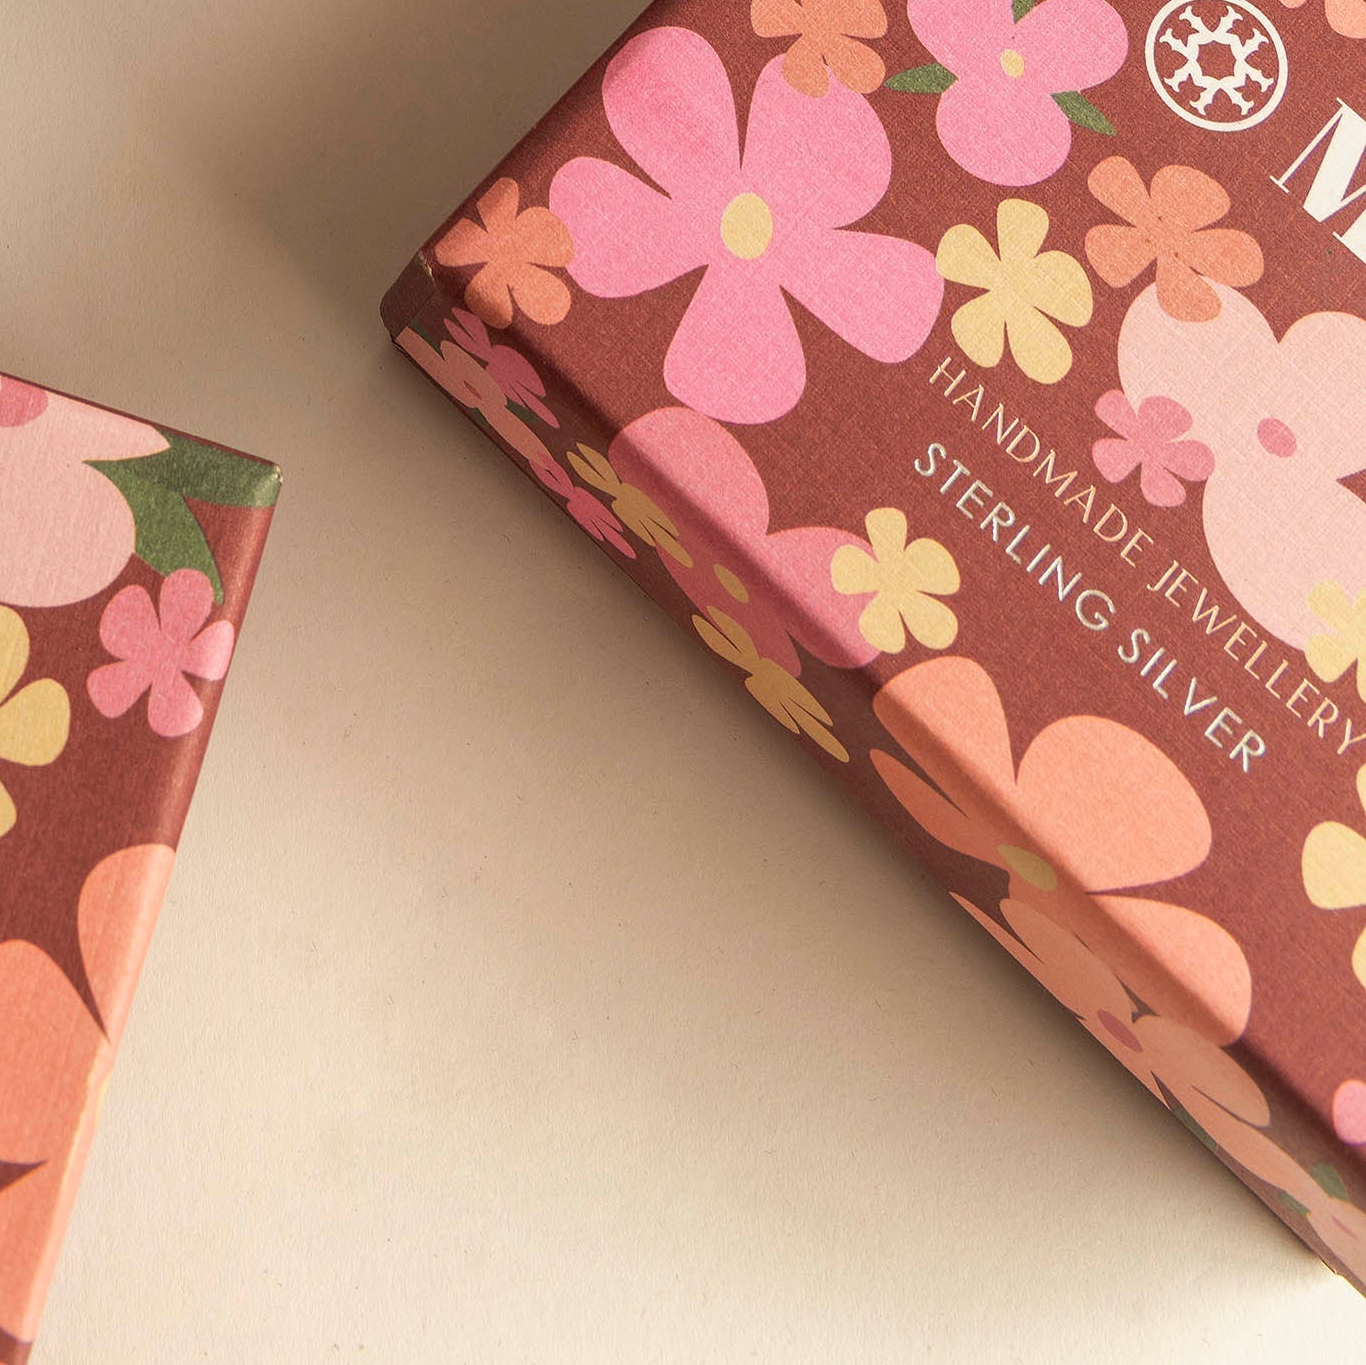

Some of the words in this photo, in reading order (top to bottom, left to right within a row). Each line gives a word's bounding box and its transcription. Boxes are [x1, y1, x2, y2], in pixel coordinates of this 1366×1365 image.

[913, 442, 1116, 632] STERLING
[1117, 628, 1267, 774] SILVER
[929, 356, 1154, 568] HANDMADE
[1146, 559, 1366, 756] JEWELLERY
